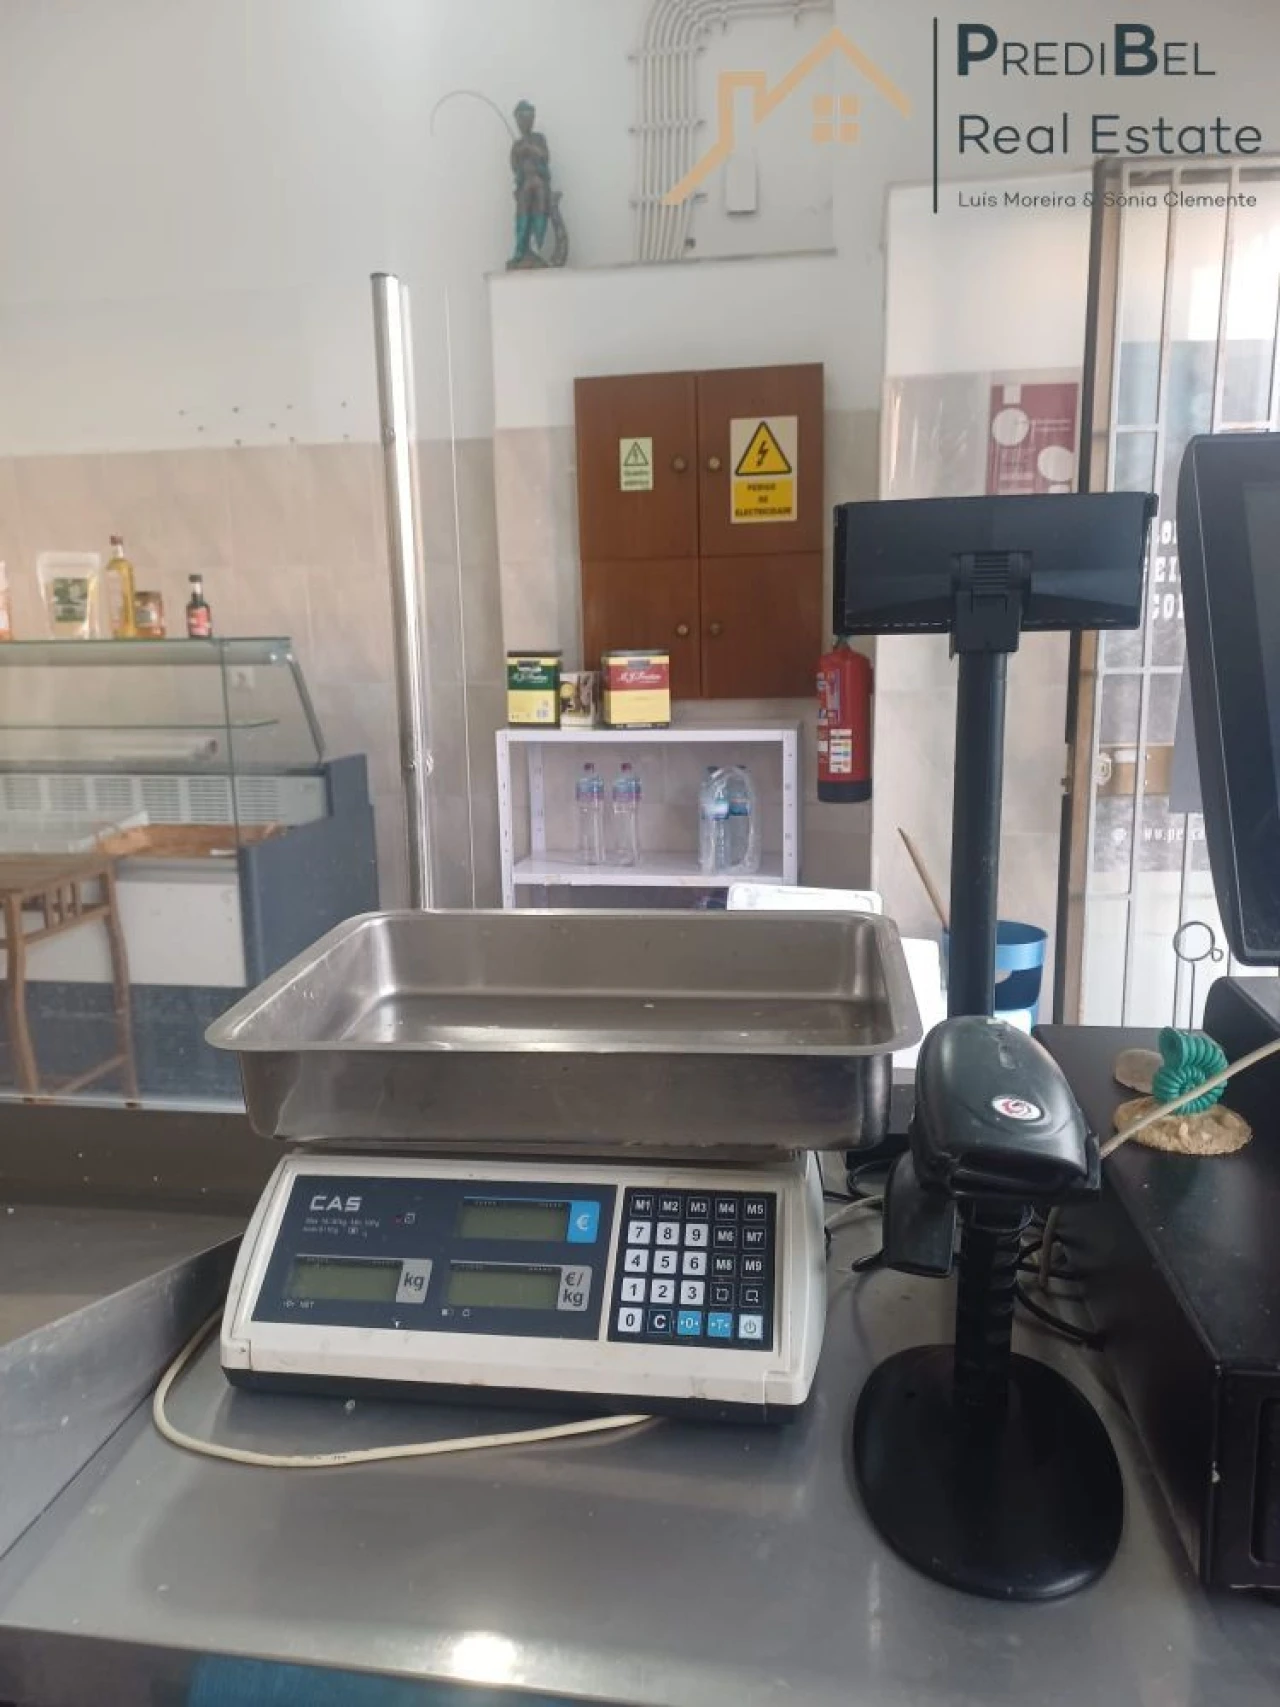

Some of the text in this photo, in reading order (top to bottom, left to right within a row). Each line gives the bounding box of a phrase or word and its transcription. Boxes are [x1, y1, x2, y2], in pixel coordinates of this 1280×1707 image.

[309, 1195, 362, 1212] CAS
[634, 1199, 764, 1215] M1 M2 M3 M4 M5
[575, 1214, 591, 1231] €
[635, 1226, 764, 1242] 7 8 9 M6 M7
[631, 1254, 762, 1271] 4 5 6 M8 M9
[403, 1272, 424, 1291] kg
[564, 1271, 584, 1287] €/
[562, 1289, 584, 1307] kg
[629, 1283, 697, 1299] 1 2 3
[625, 1313, 635, 1327] 0
[653, 1314, 666, 1329] C
